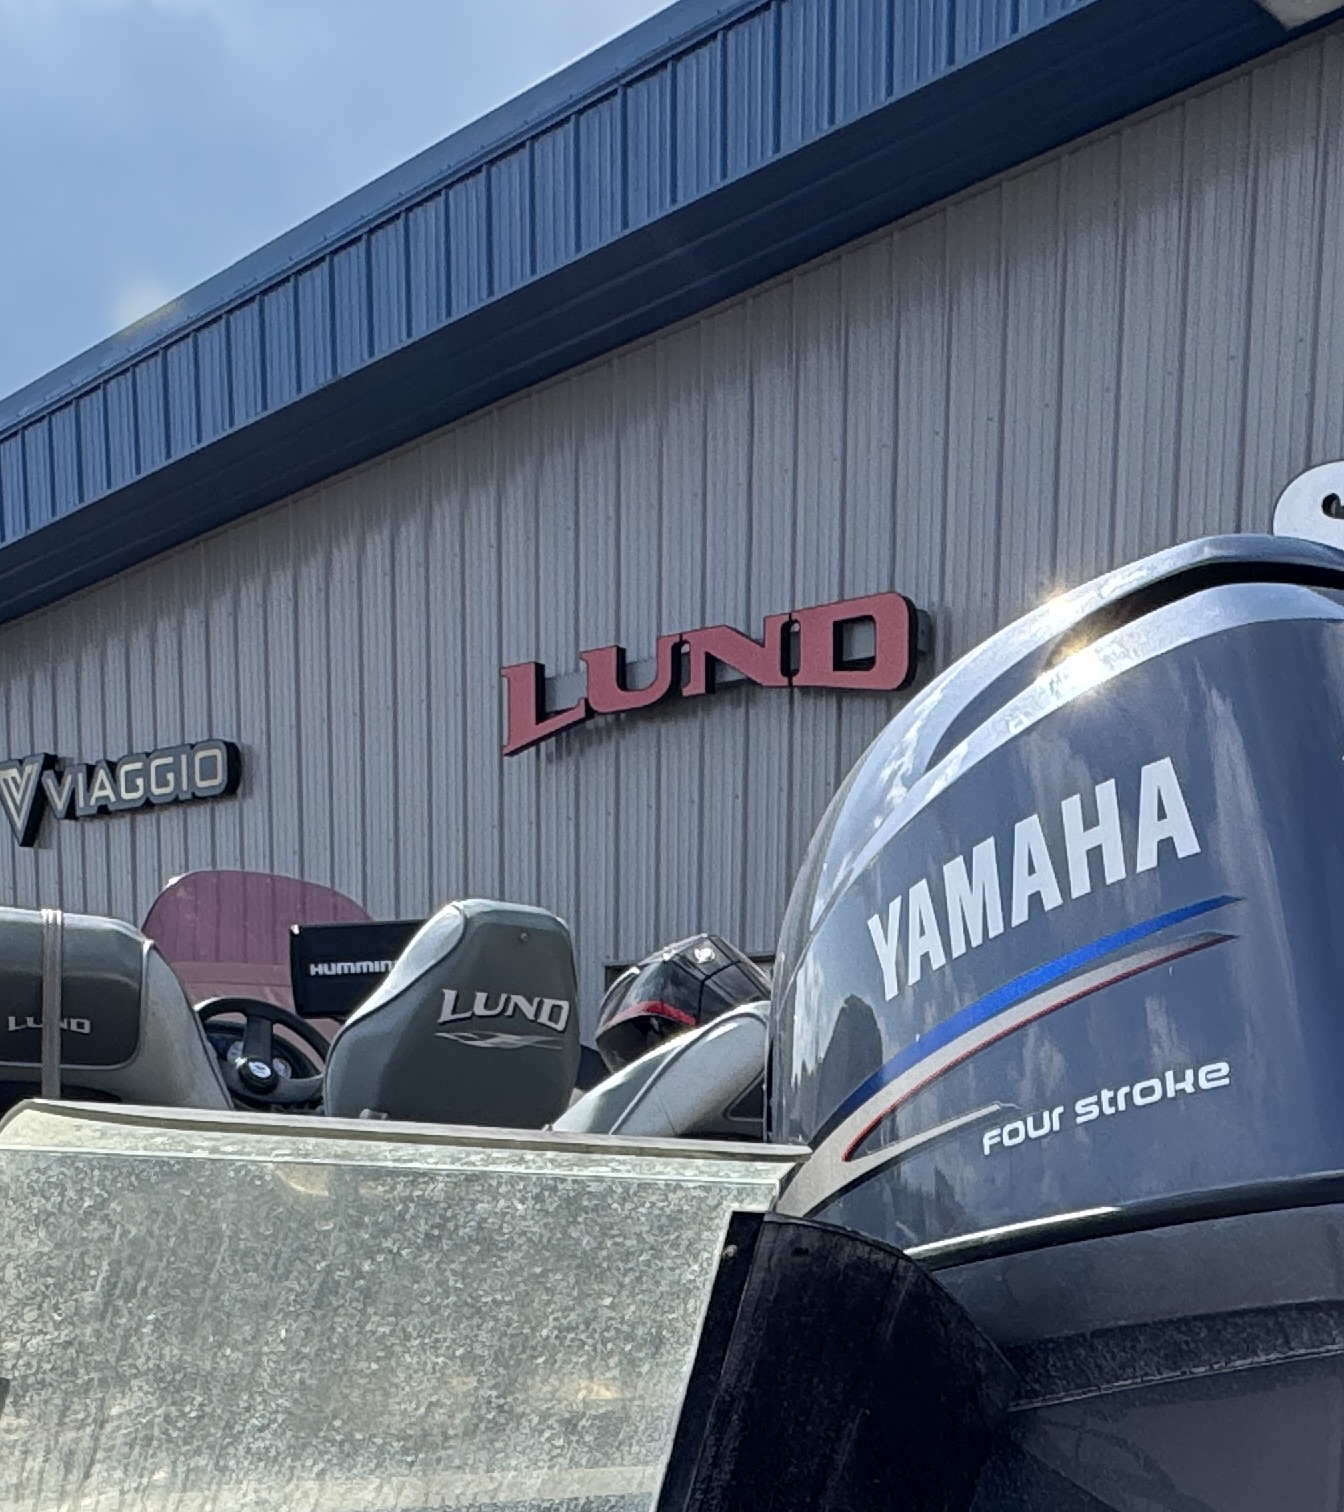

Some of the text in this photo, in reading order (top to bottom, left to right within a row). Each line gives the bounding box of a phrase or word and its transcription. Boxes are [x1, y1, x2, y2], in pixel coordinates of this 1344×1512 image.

[500, 592, 916, 758] LUND
[44, 746, 224, 812] VIAGGIO
[866, 756, 1202, 1001] YAMAHA
[440, 988, 570, 1032] LUND
